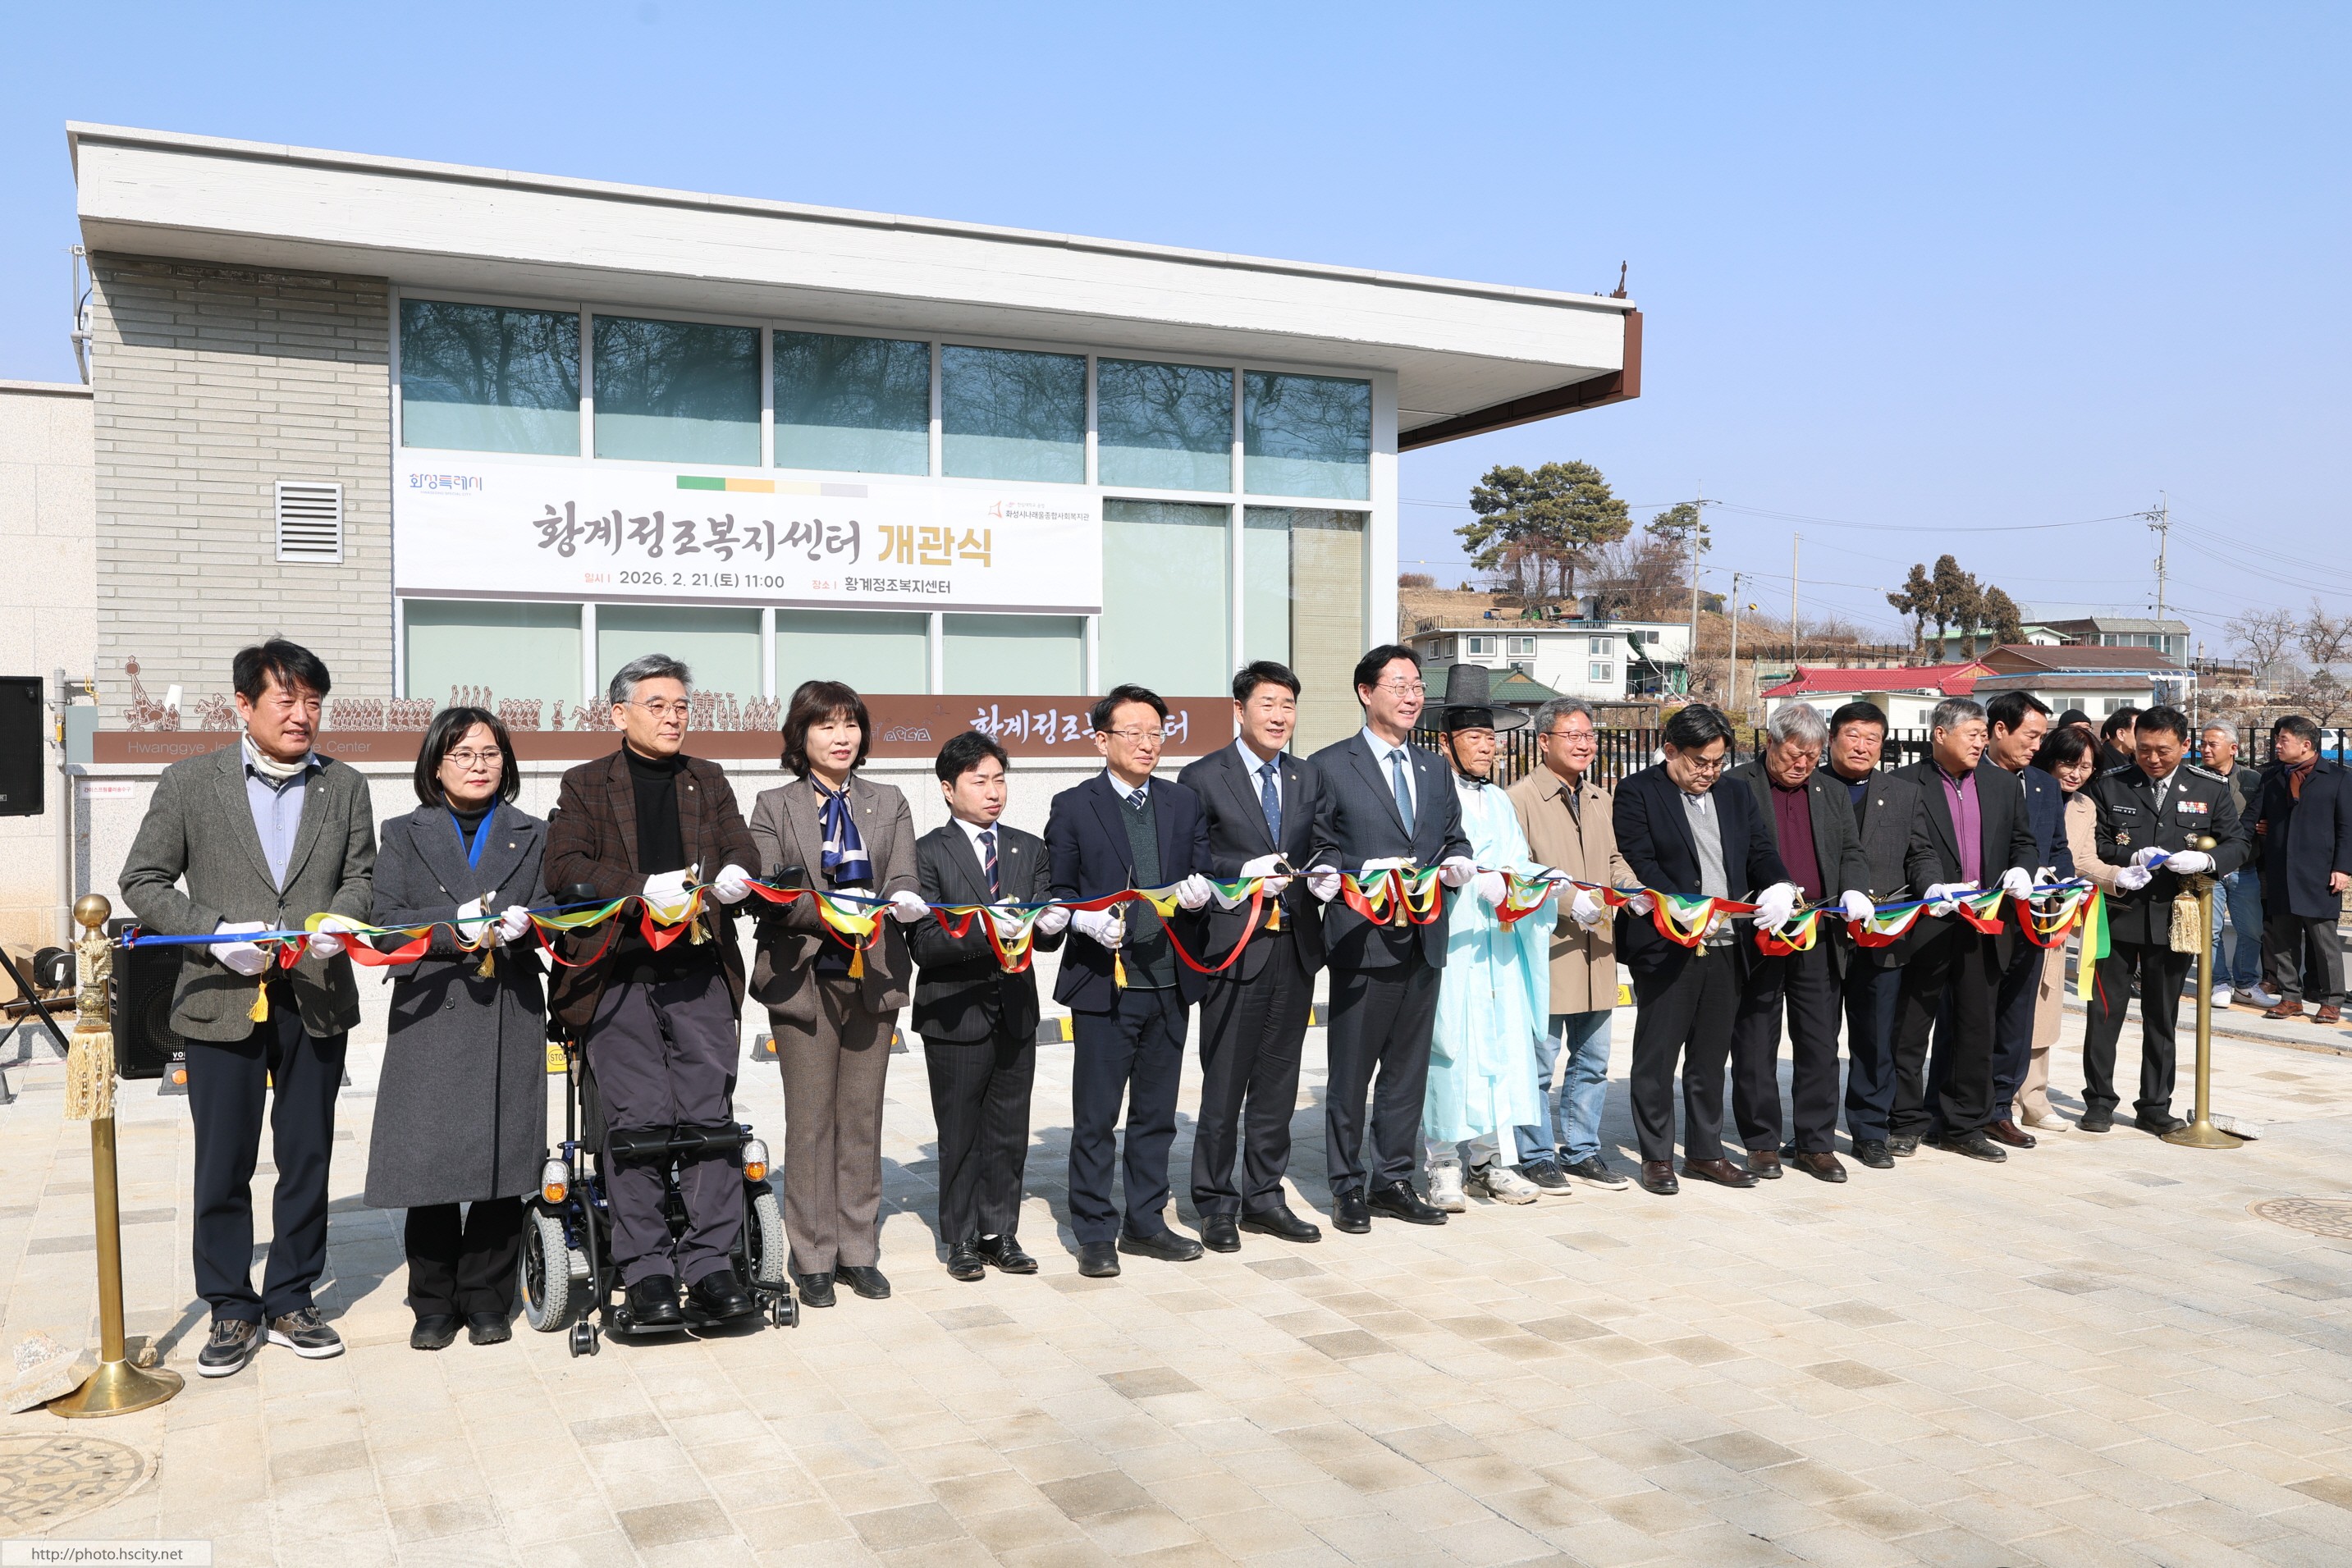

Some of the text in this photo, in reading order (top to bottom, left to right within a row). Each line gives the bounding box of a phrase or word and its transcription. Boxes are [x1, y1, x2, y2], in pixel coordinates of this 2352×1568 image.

[410, 473, 483, 491] 화성특례시
[1005, 510, 1090, 521] 화성시나래울종합사회복지관
[877, 523, 992, 568] 개관식
[584, 570, 785, 588] 일시 2026. 2. 21.(토) 11:00
[812, 576, 950, 594] 장소 황계정조복지센터
[970, 703, 1188, 745] 황계정조터
[128, 741, 205, 755] Hwanggye
[327, 740, 371, 752] Center
